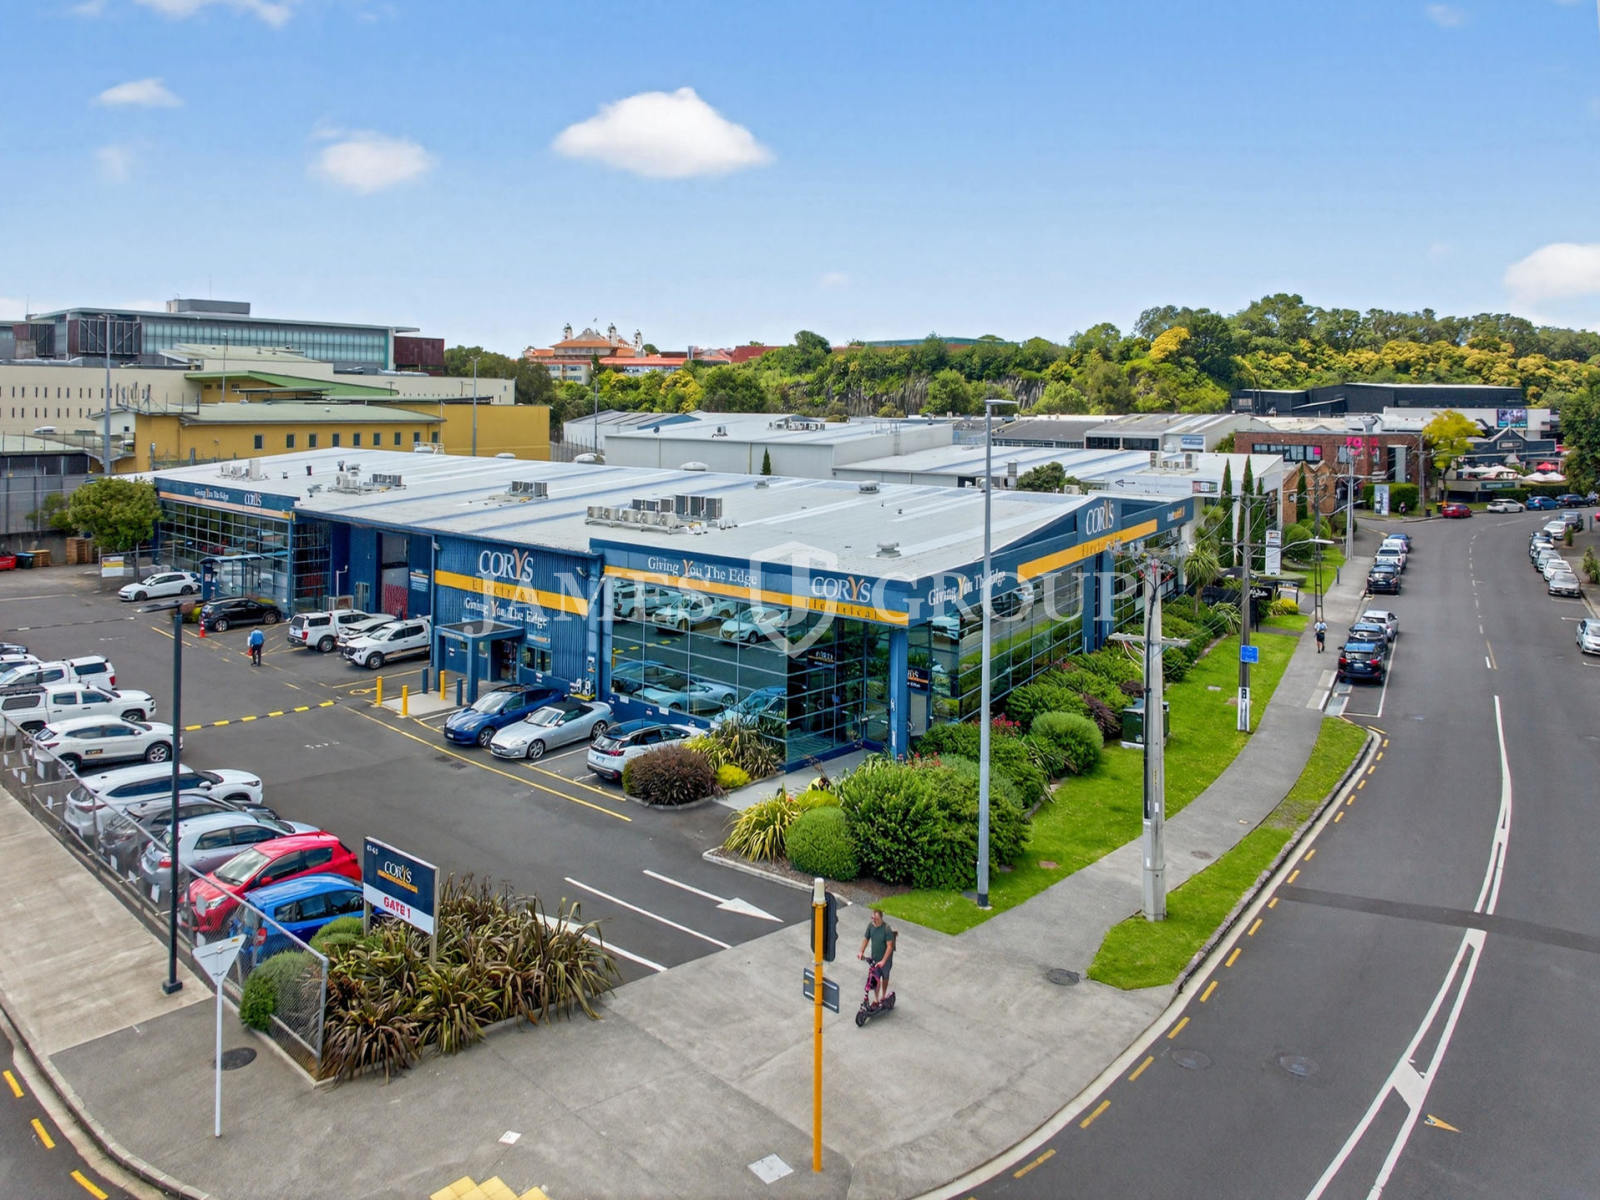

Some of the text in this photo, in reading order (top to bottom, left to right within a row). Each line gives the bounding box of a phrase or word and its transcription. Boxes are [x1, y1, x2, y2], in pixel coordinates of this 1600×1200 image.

[1085, 500, 1114, 535] CORYS
[479, 548, 534, 582] CORYS
[647, 556, 757, 588] Giving You The Edge
[811, 575, 871, 603] CORYS
[928, 586, 957, 606] Giving
[957, 575, 973, 600] You
[526, 609, 548, 629] Edge
[384, 860, 412, 884] CORYS
[383, 896, 411, 920] GATE 1
